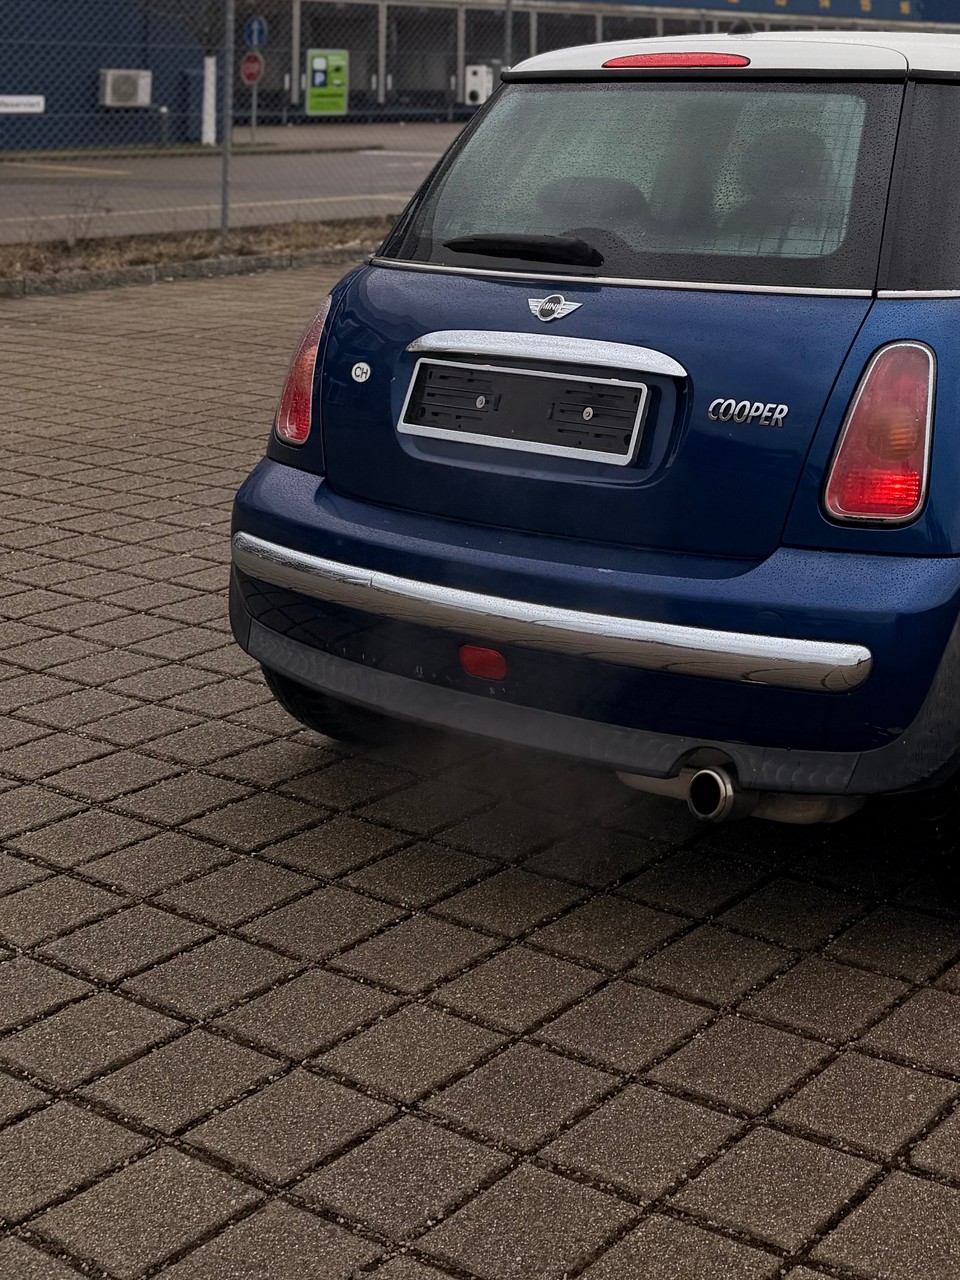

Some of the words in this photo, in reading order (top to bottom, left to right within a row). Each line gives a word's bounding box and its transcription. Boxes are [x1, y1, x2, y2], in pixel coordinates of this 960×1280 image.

[314, 72, 325, 86] P
[541, 302, 560, 311] MINI
[354, 366, 369, 380] CH
[707, 398, 789, 428] COOPER
